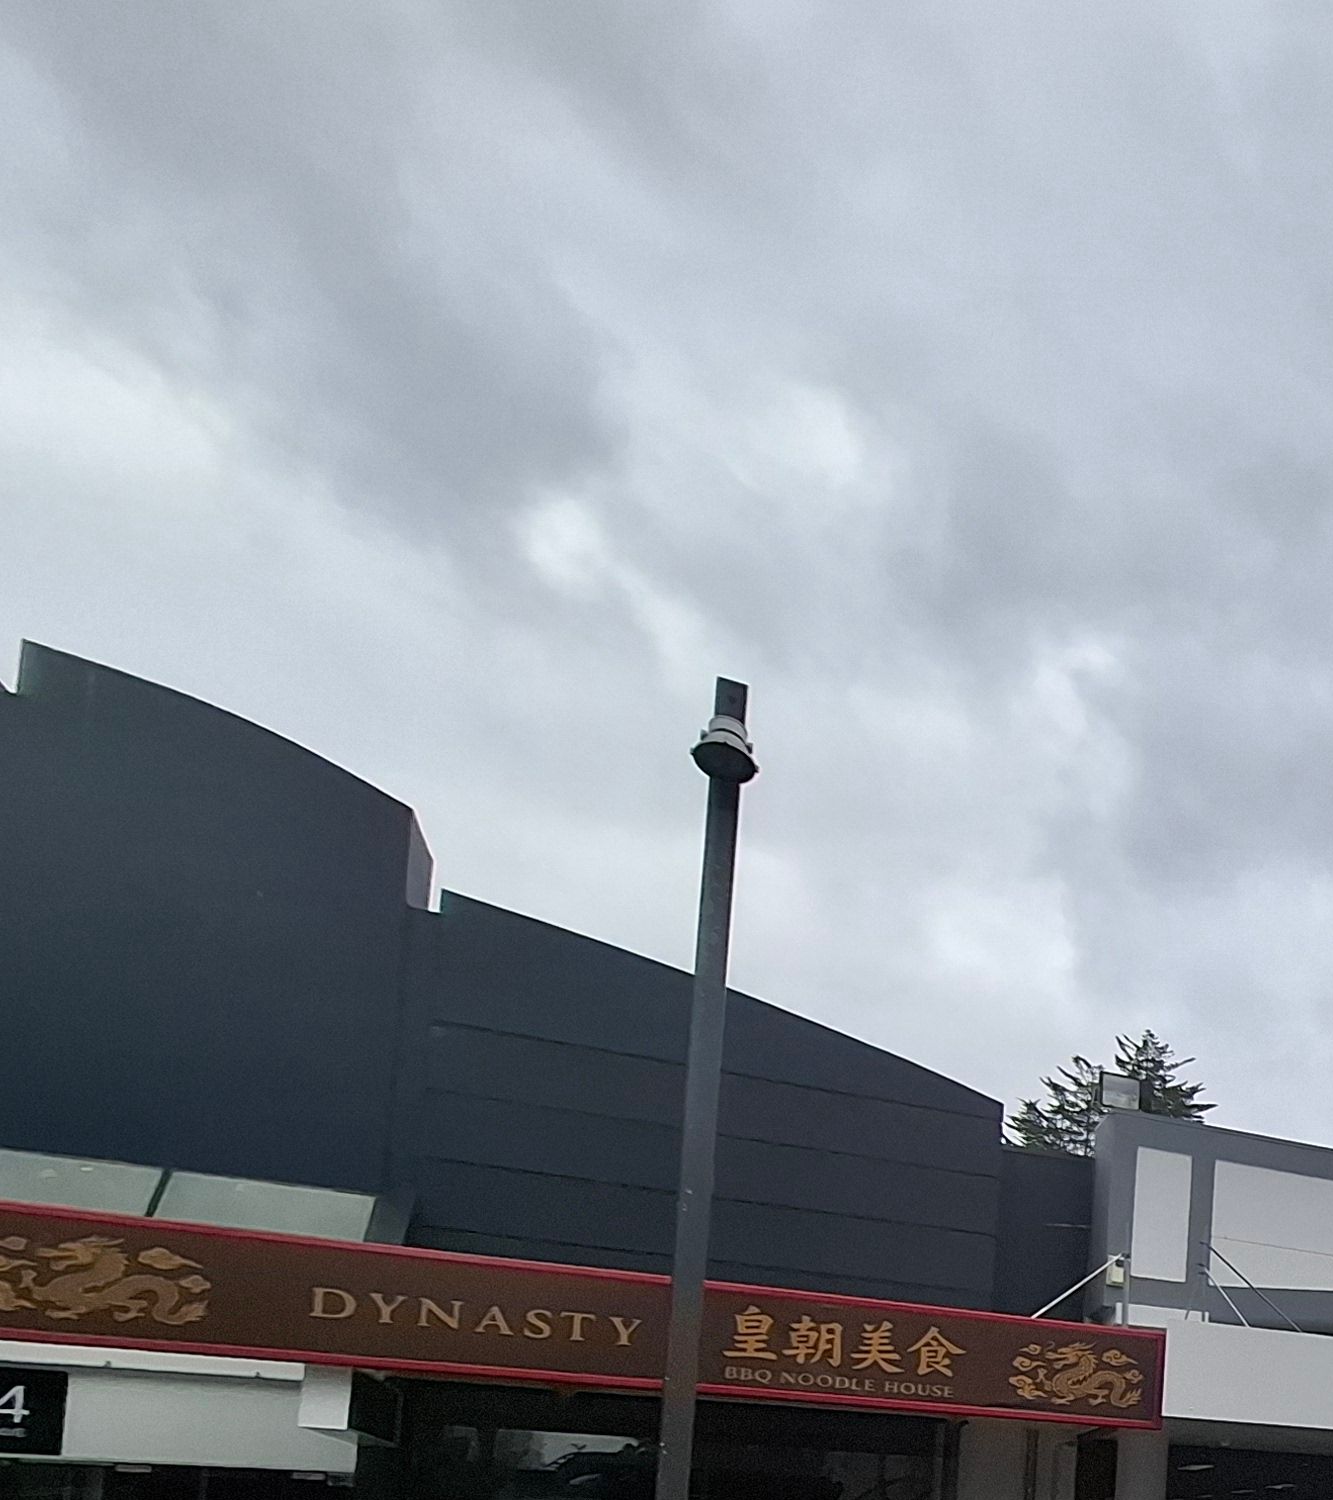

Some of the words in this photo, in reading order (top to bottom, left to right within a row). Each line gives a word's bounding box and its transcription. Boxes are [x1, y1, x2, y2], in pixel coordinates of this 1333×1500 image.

[309, 1287, 642, 1346] DYNASTY
[722, 1305, 967, 1377] 皇朝美食
[724, 1366, 772, 1384] BBQ
[779, 1371, 875, 1391] NOODLE
[885, 1381, 954, 1398] HOUSE
